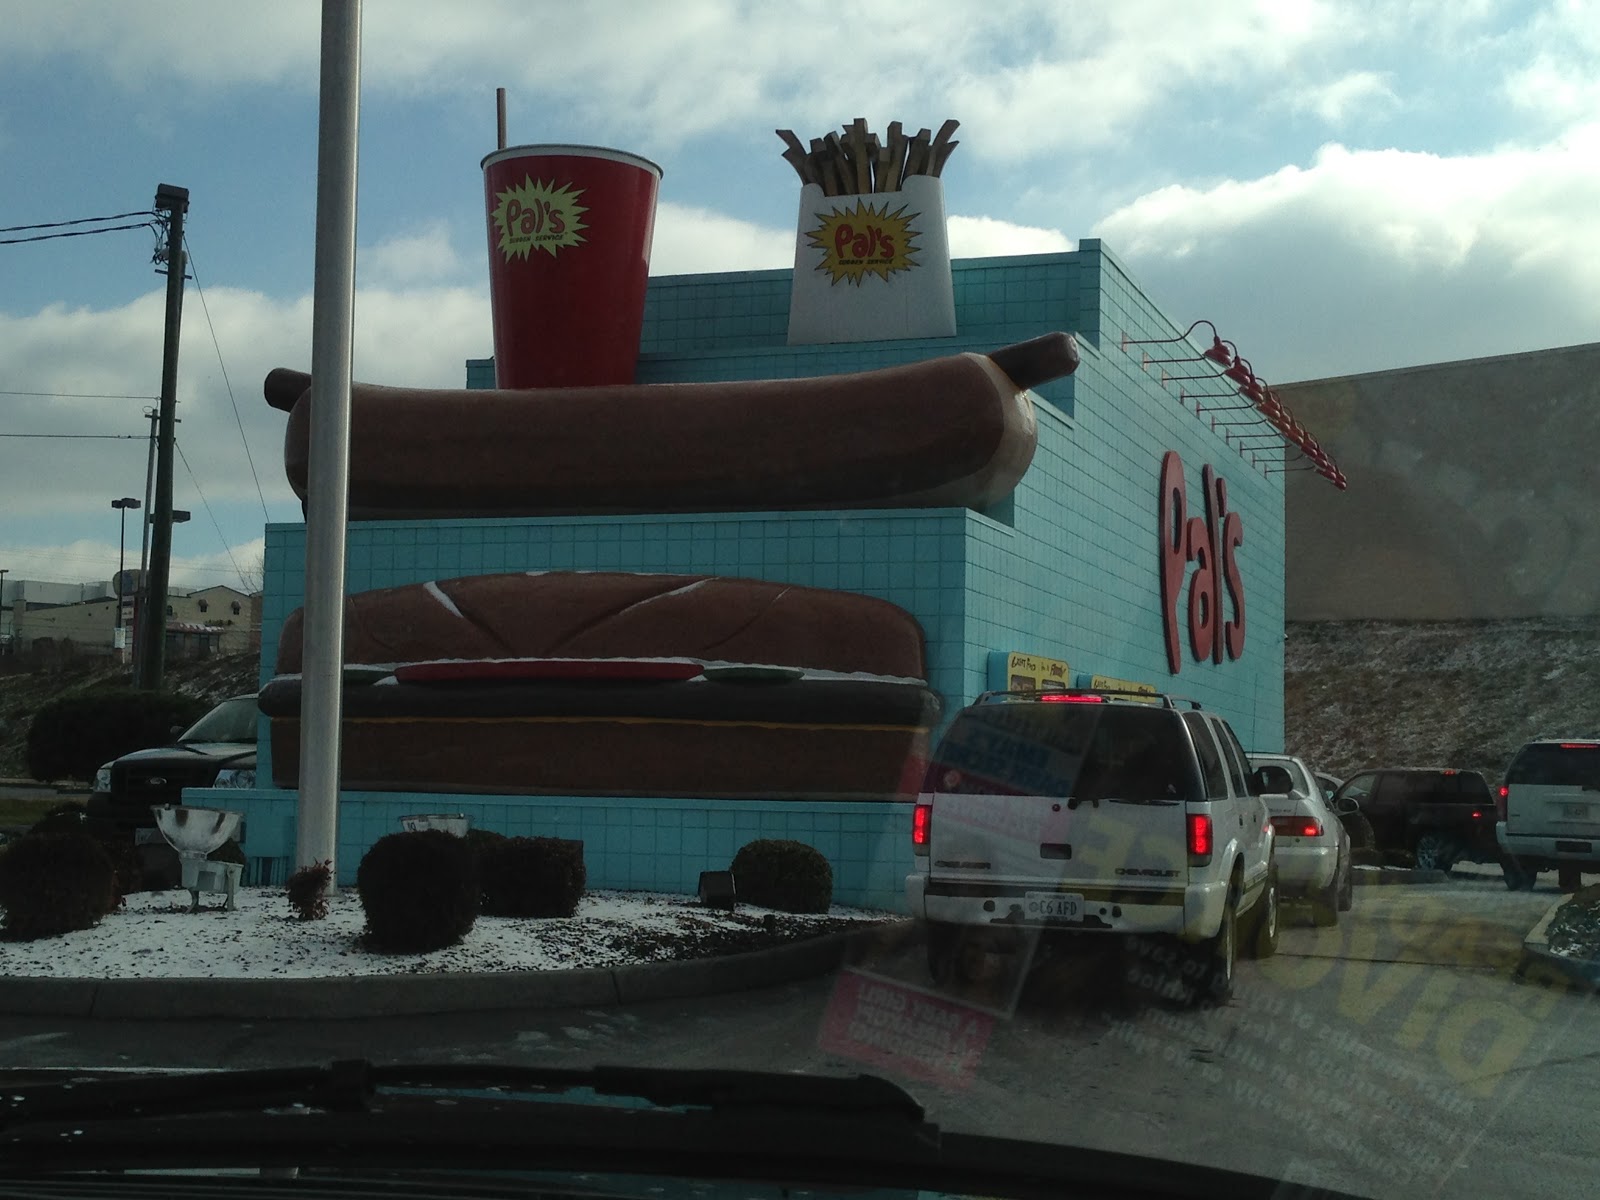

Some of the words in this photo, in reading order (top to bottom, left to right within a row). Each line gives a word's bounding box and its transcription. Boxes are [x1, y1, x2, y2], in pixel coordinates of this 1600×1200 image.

[507, 198, 565, 236] Pal's
[835, 224, 895, 258] Pal's
[1159, 450, 1245, 674] Pal's
